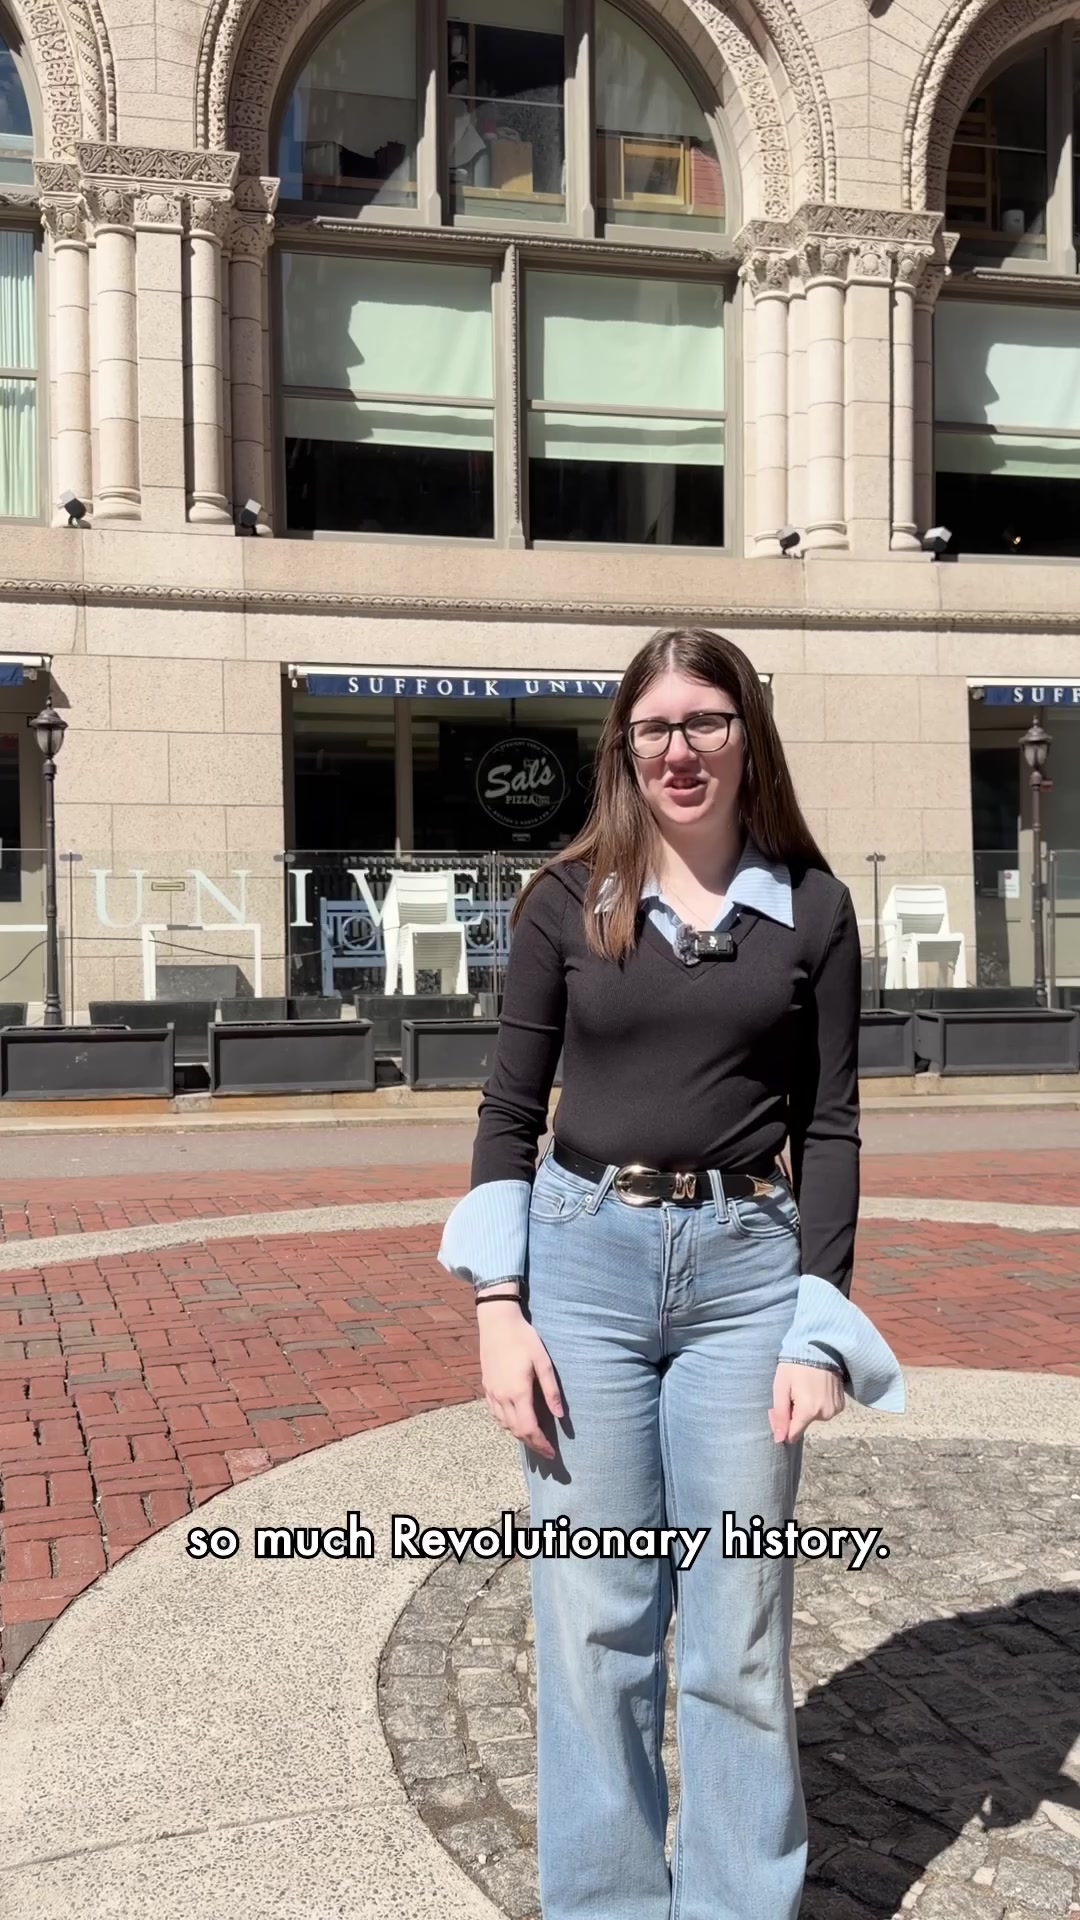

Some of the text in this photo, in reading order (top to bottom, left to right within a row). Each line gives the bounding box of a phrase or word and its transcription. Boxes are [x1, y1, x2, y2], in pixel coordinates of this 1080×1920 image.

[348, 676, 621, 696] SUFFOLK UNIV
[1013, 686, 1080, 703] SUFF
[484, 756, 556, 798] Sal's
[505, 795, 535, 805] PIZZA
